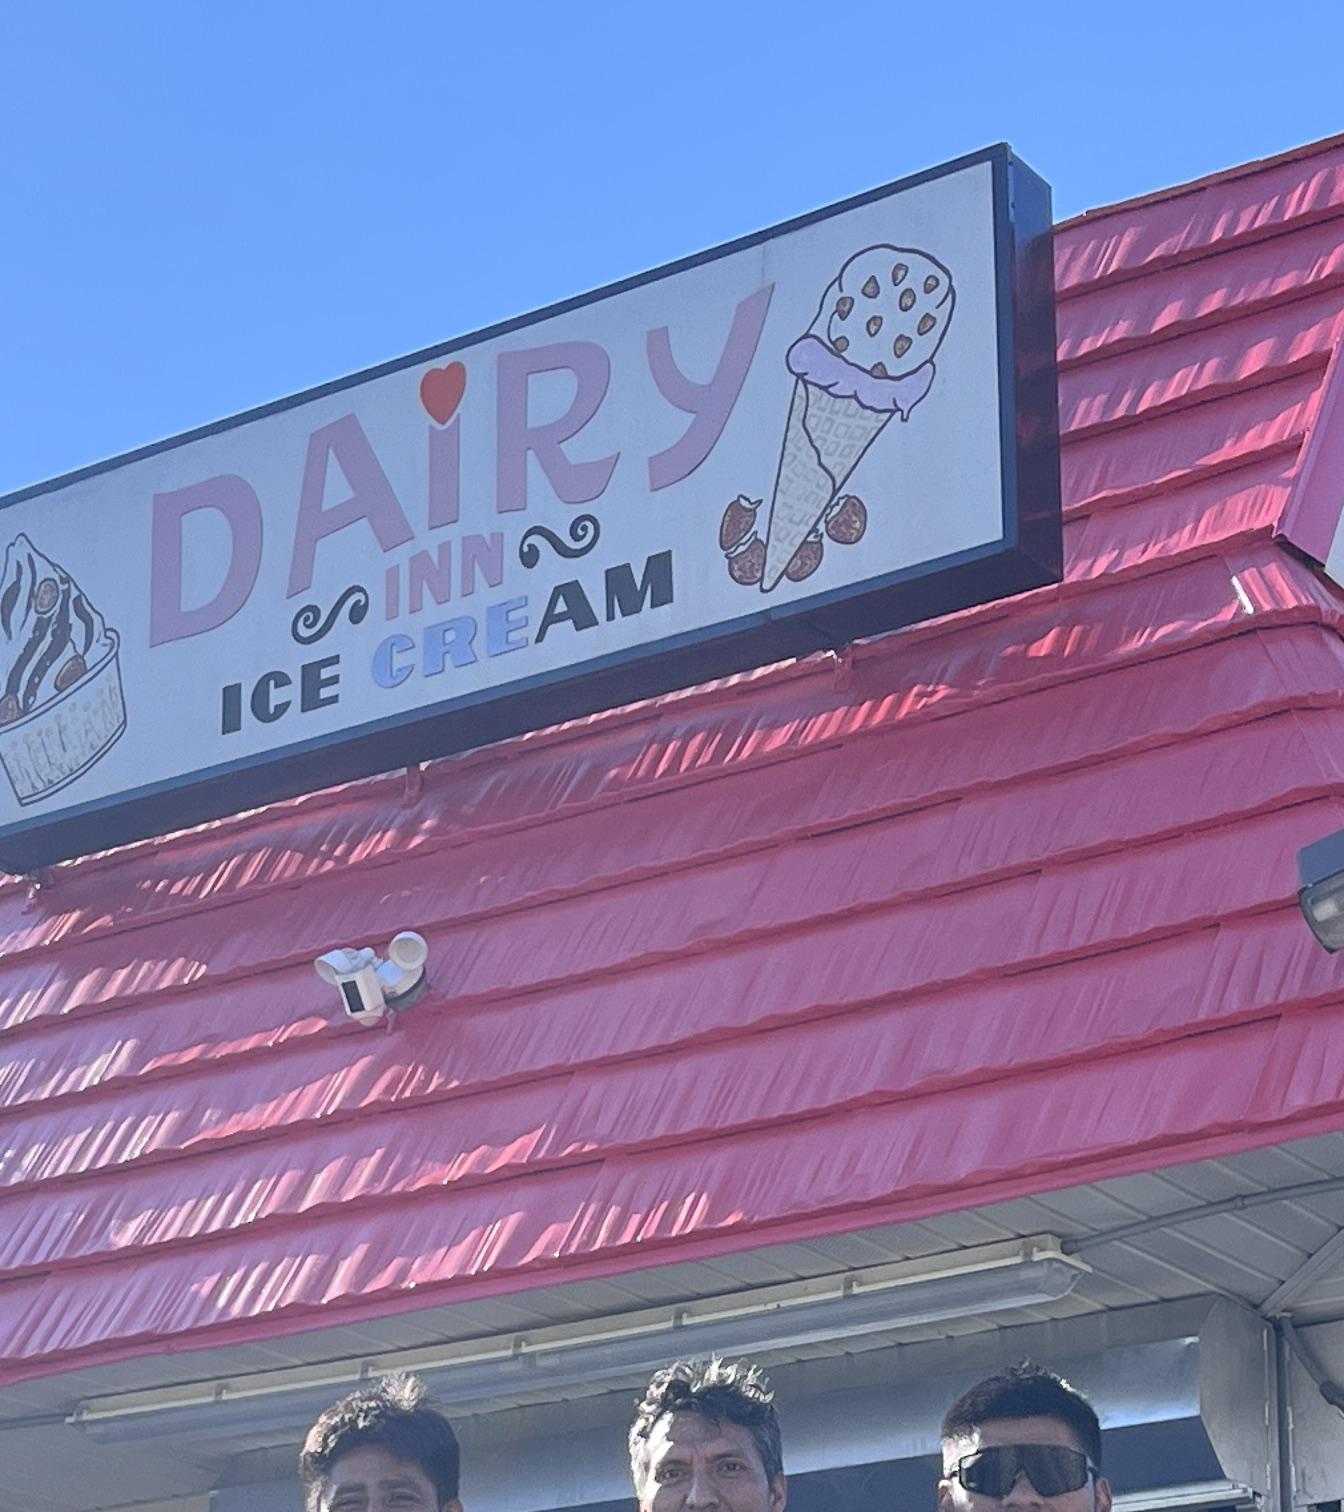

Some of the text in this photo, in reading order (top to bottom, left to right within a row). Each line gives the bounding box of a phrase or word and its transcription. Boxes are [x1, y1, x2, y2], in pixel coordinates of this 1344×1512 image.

[220, 549, 675, 736] ICE CREAM
[384, 531, 504, 622] INN
